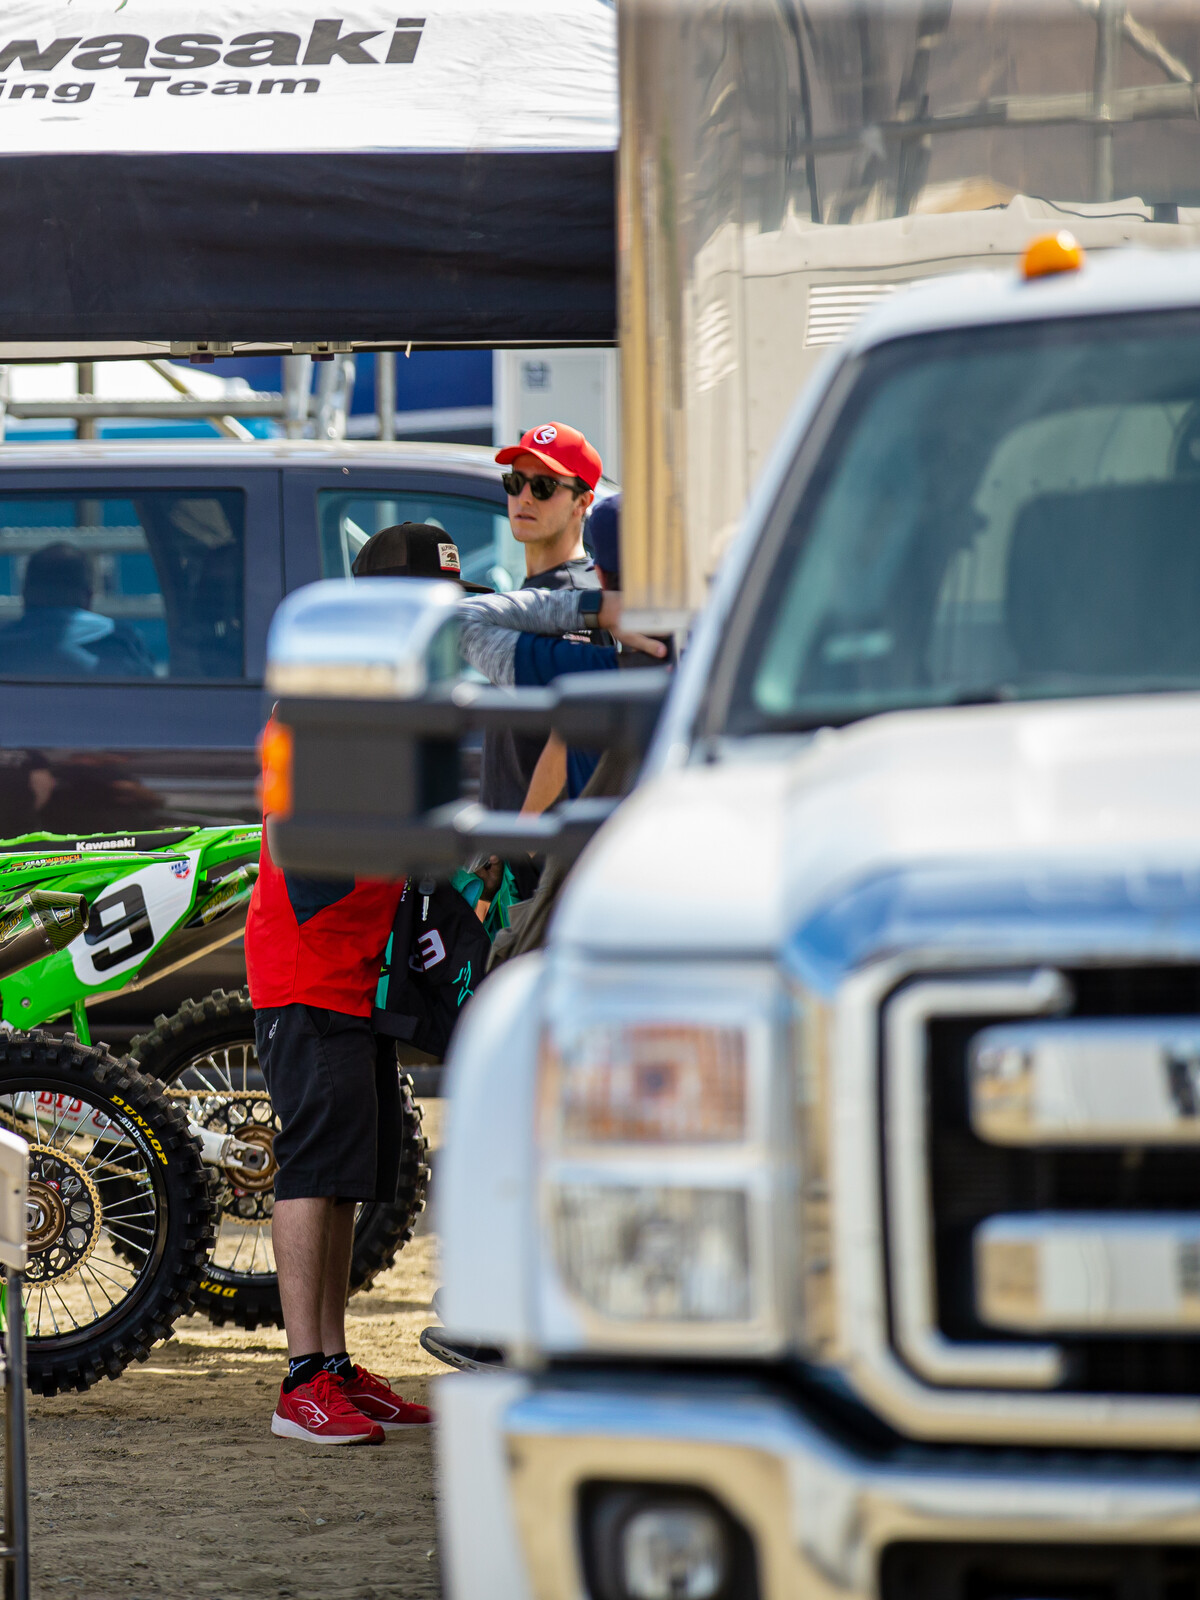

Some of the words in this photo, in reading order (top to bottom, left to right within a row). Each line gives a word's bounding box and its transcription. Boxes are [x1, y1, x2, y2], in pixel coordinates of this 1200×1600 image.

[124, 74, 321, 99] Team
[76, 838, 136, 851] Kawasaki
[84, 883, 155, 972] 9
[109, 1094, 169, 1166] DUNLOP
